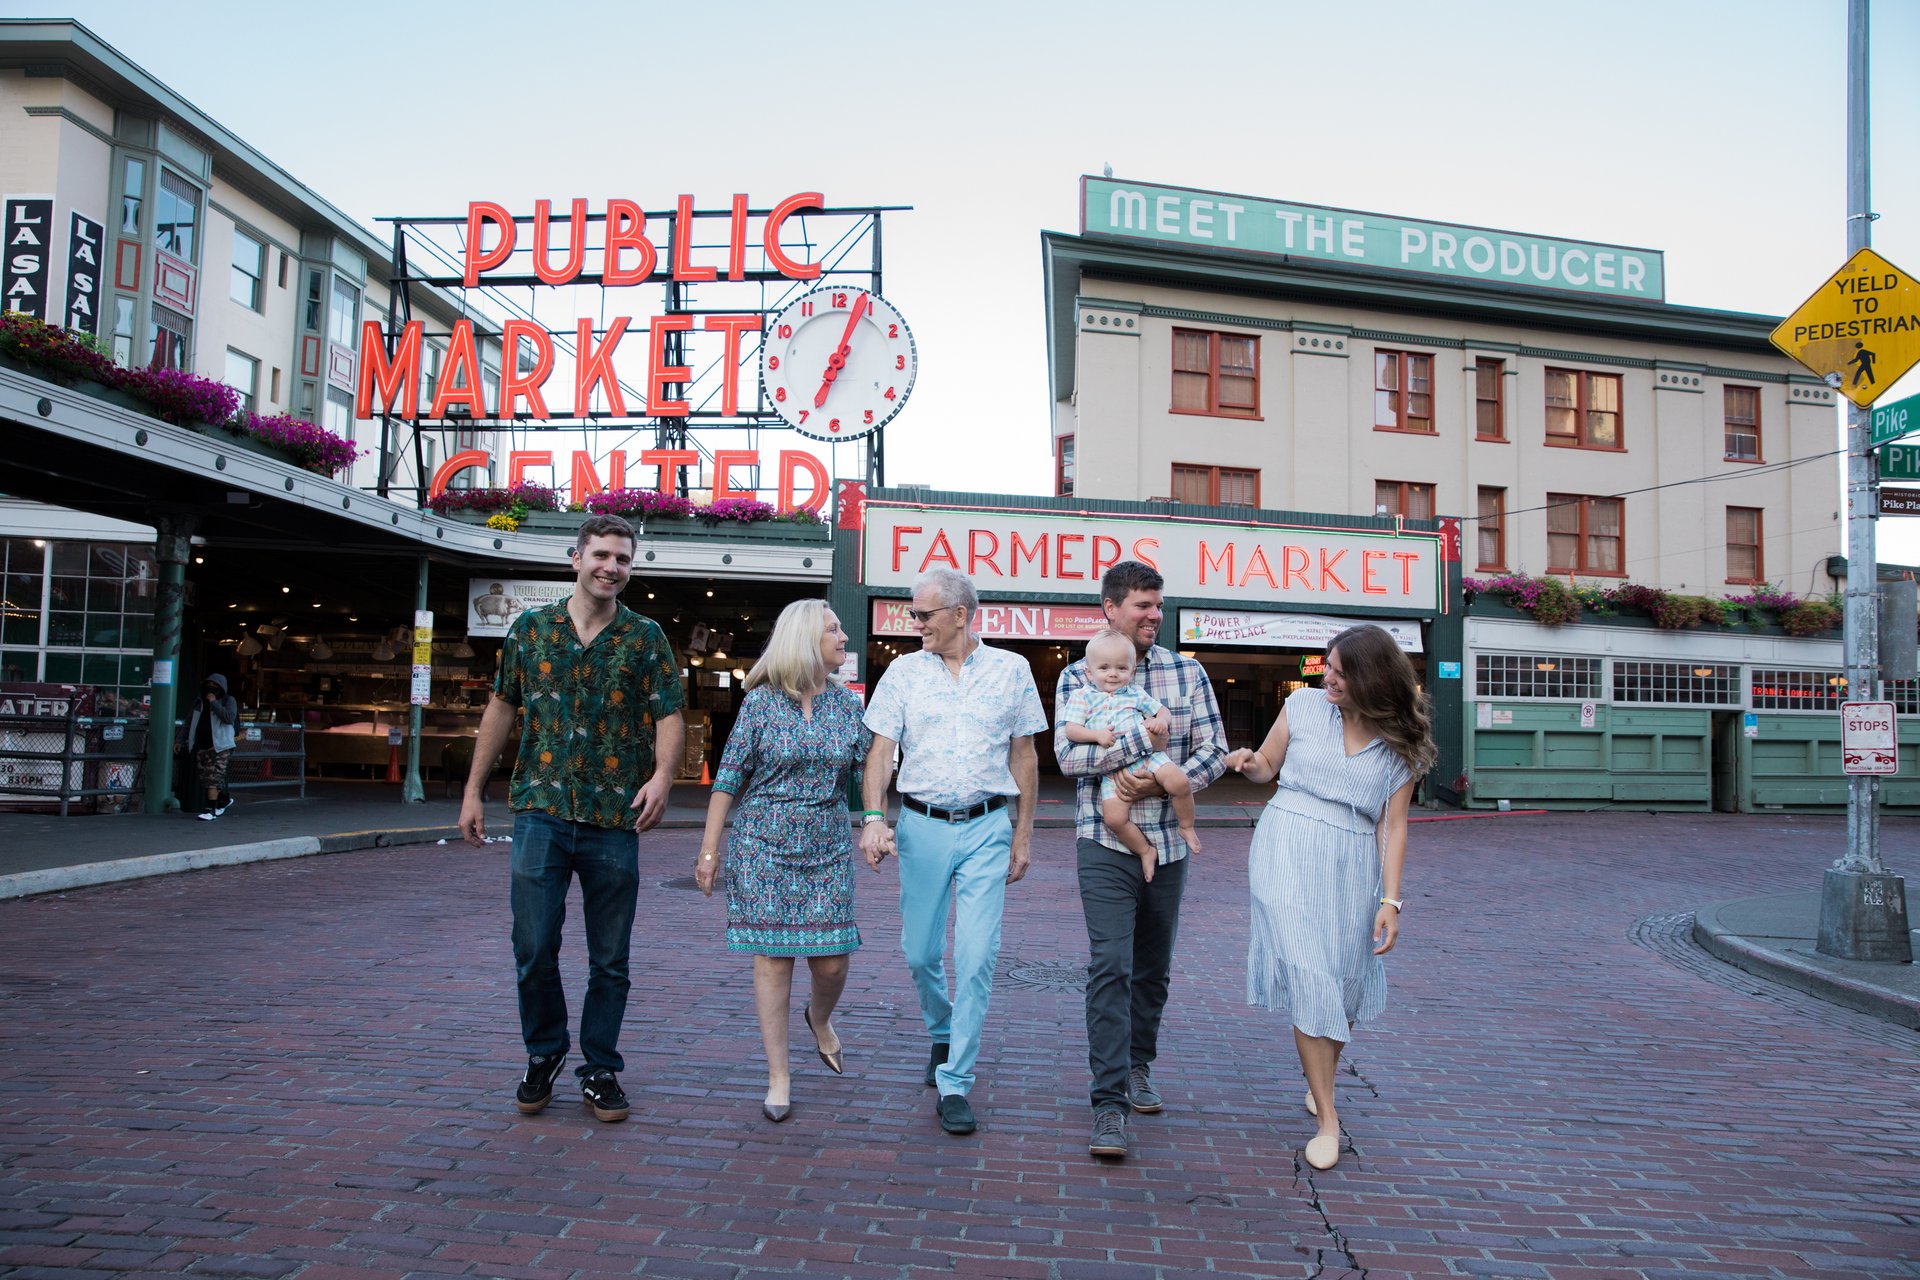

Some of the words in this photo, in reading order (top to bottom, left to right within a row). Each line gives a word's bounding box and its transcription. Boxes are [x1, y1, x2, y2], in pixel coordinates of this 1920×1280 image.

[463, 192, 825, 287] PUBLIC
[1110, 188, 1245, 241] MEET
[1276, 210, 1365, 257] THE
[1401, 226, 1646, 292] PRODUCER
[1835, 273, 1898, 295] YIELD
[832, 293, 847, 308] 12
[1852, 297, 1878, 315] TO
[802, 302, 813, 316] 11
[868, 301, 873, 316] 1
[778, 324, 792, 339] 10
[888, 323, 898, 338] 2
[356, 314, 763, 420] MARKET
[769, 356, 779, 370] 9
[895, 355, 905, 370] 3
[775, 387, 786, 402] 8
[884, 386, 896, 401] 4
[799, 410, 809, 424] 7
[863, 410, 873, 424] 5
[1875, 407, 1908, 438] Pike
[829, 418, 840, 433] 6
[1882, 500, 1904, 509] Pike
[892, 525, 1160, 581] FARMERS
[1199, 541, 1420, 595] MARKET
[513, 585, 536, 597] YOUR
[886, 603, 911, 618] WE
[880, 621, 913, 632] ARE
[974, 606, 1051, 636] EN!
[1203, 614, 1241, 627] POWER
[1206, 627, 1231, 640] PIKE
[1234, 624, 1267, 640] PLACE
[1849, 720, 1889, 732] STOPS
